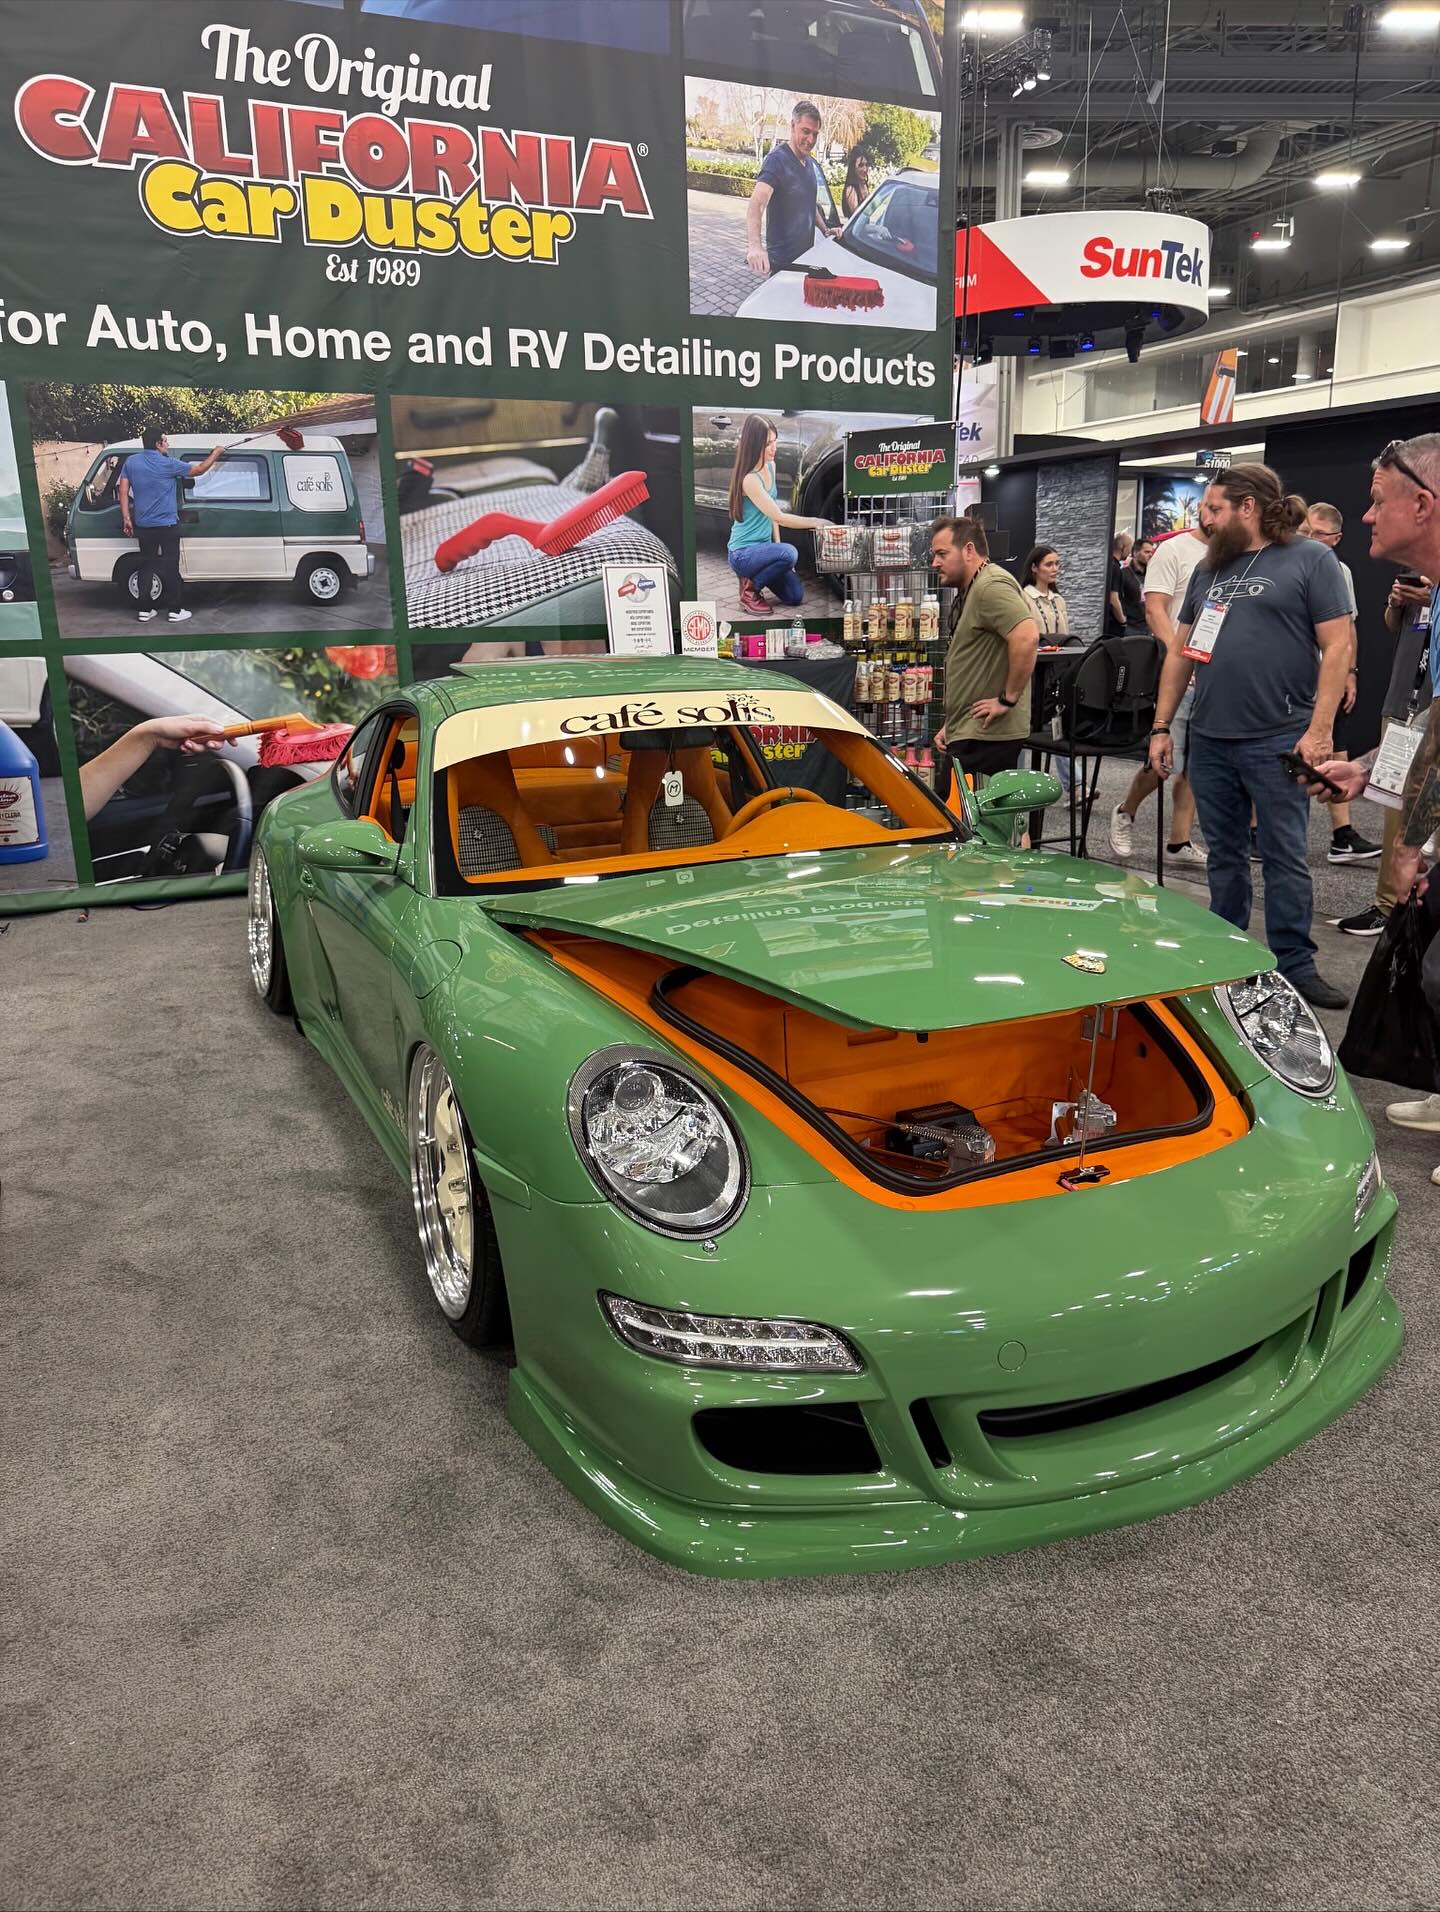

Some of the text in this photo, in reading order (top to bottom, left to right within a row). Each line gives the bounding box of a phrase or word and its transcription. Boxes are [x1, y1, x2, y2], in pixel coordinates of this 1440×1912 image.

[201, 23, 493, 117] The Original
[137, 157, 576, 266] Car Duster
[325, 254, 421, 288] Est 1989
[1080, 236, 1203, 287] SunTek
[86, 304, 227, 363] Auto,
[244, 312, 392, 363] Home
[408, 326, 493, 367] and
[508, 328, 568, 371] RV
[583, 332, 761, 388] Detailing
[775, 343, 936, 388] Products
[878, 440, 920, 453] The Original
[297, 476, 314, 491] café
[868, 463, 932, 477] Car Duster
[560, 694, 775, 734] café solis
